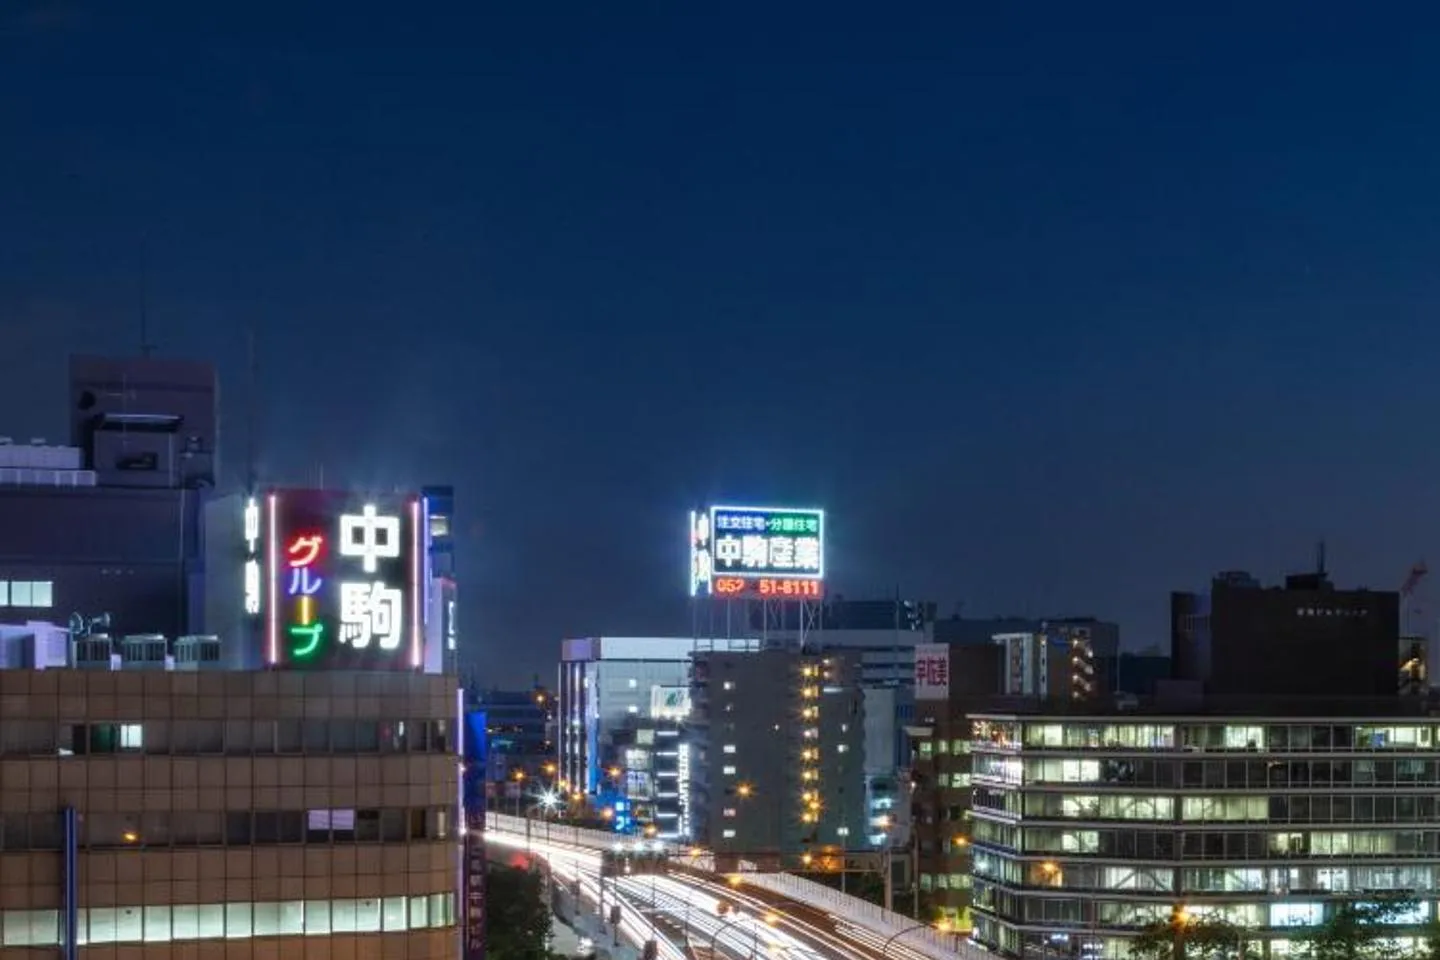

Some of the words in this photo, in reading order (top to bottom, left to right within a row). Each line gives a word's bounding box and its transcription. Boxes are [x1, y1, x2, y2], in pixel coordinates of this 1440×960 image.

[288, 533, 324, 656] グループ
[339, 503, 402, 649] 中駒
